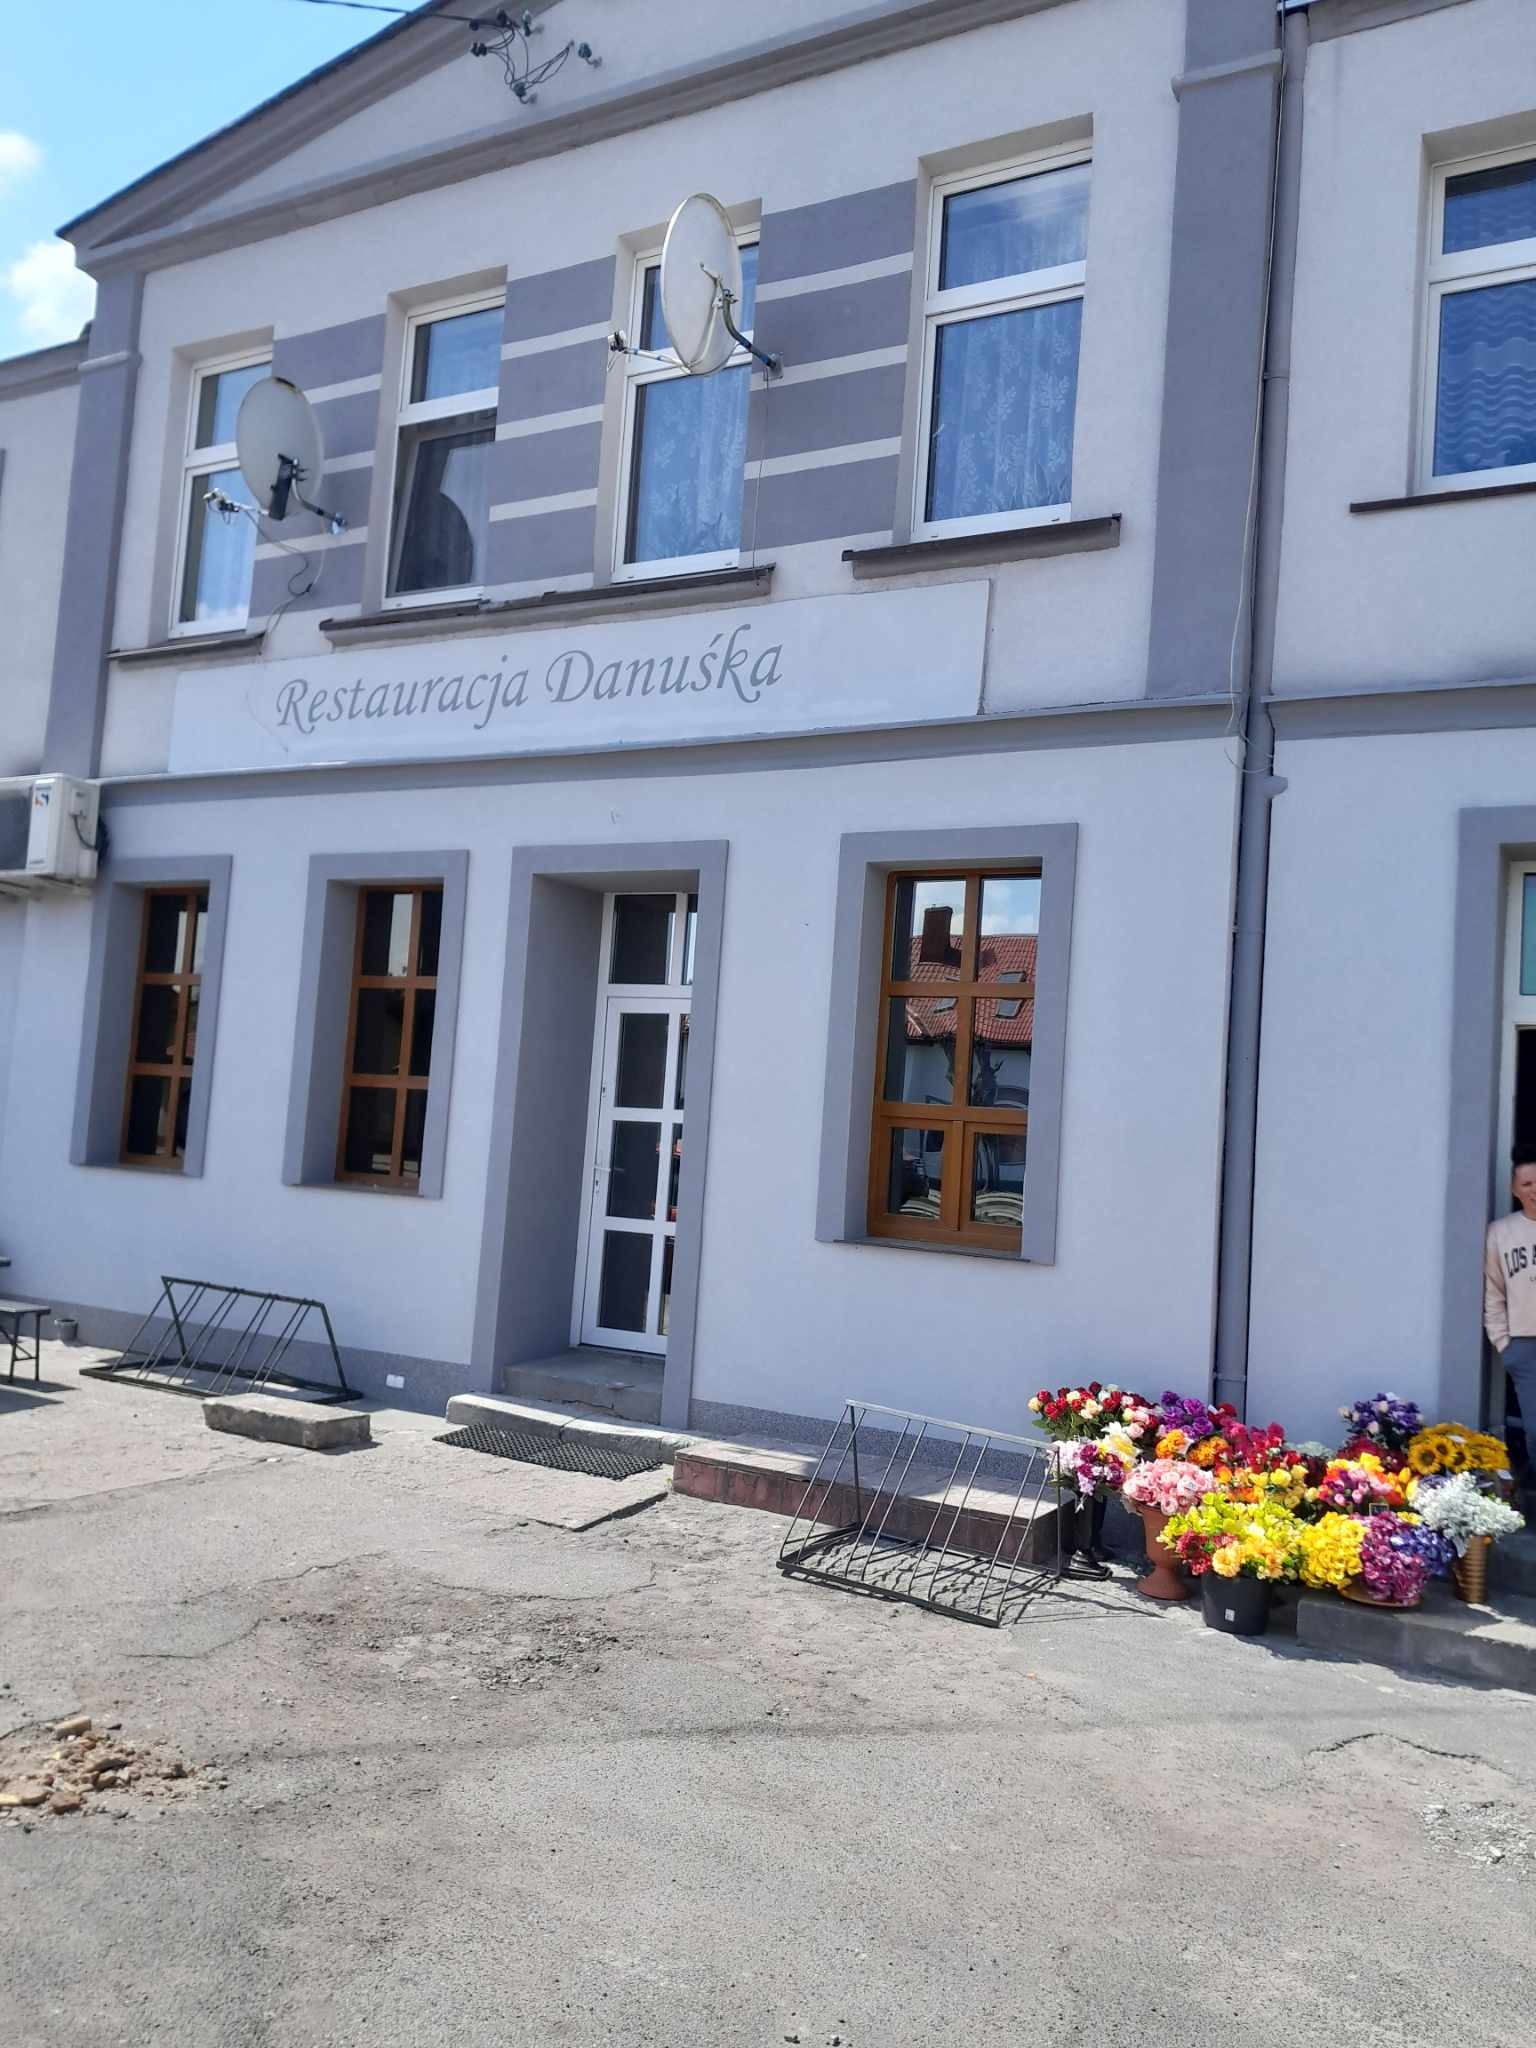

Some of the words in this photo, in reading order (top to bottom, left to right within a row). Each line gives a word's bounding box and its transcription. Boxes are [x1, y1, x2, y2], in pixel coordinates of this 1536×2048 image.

[276, 654, 529, 734] Restauracja
[545, 623, 783, 703] Danuśka
[1504, 1246, 1528, 1278] LOS
